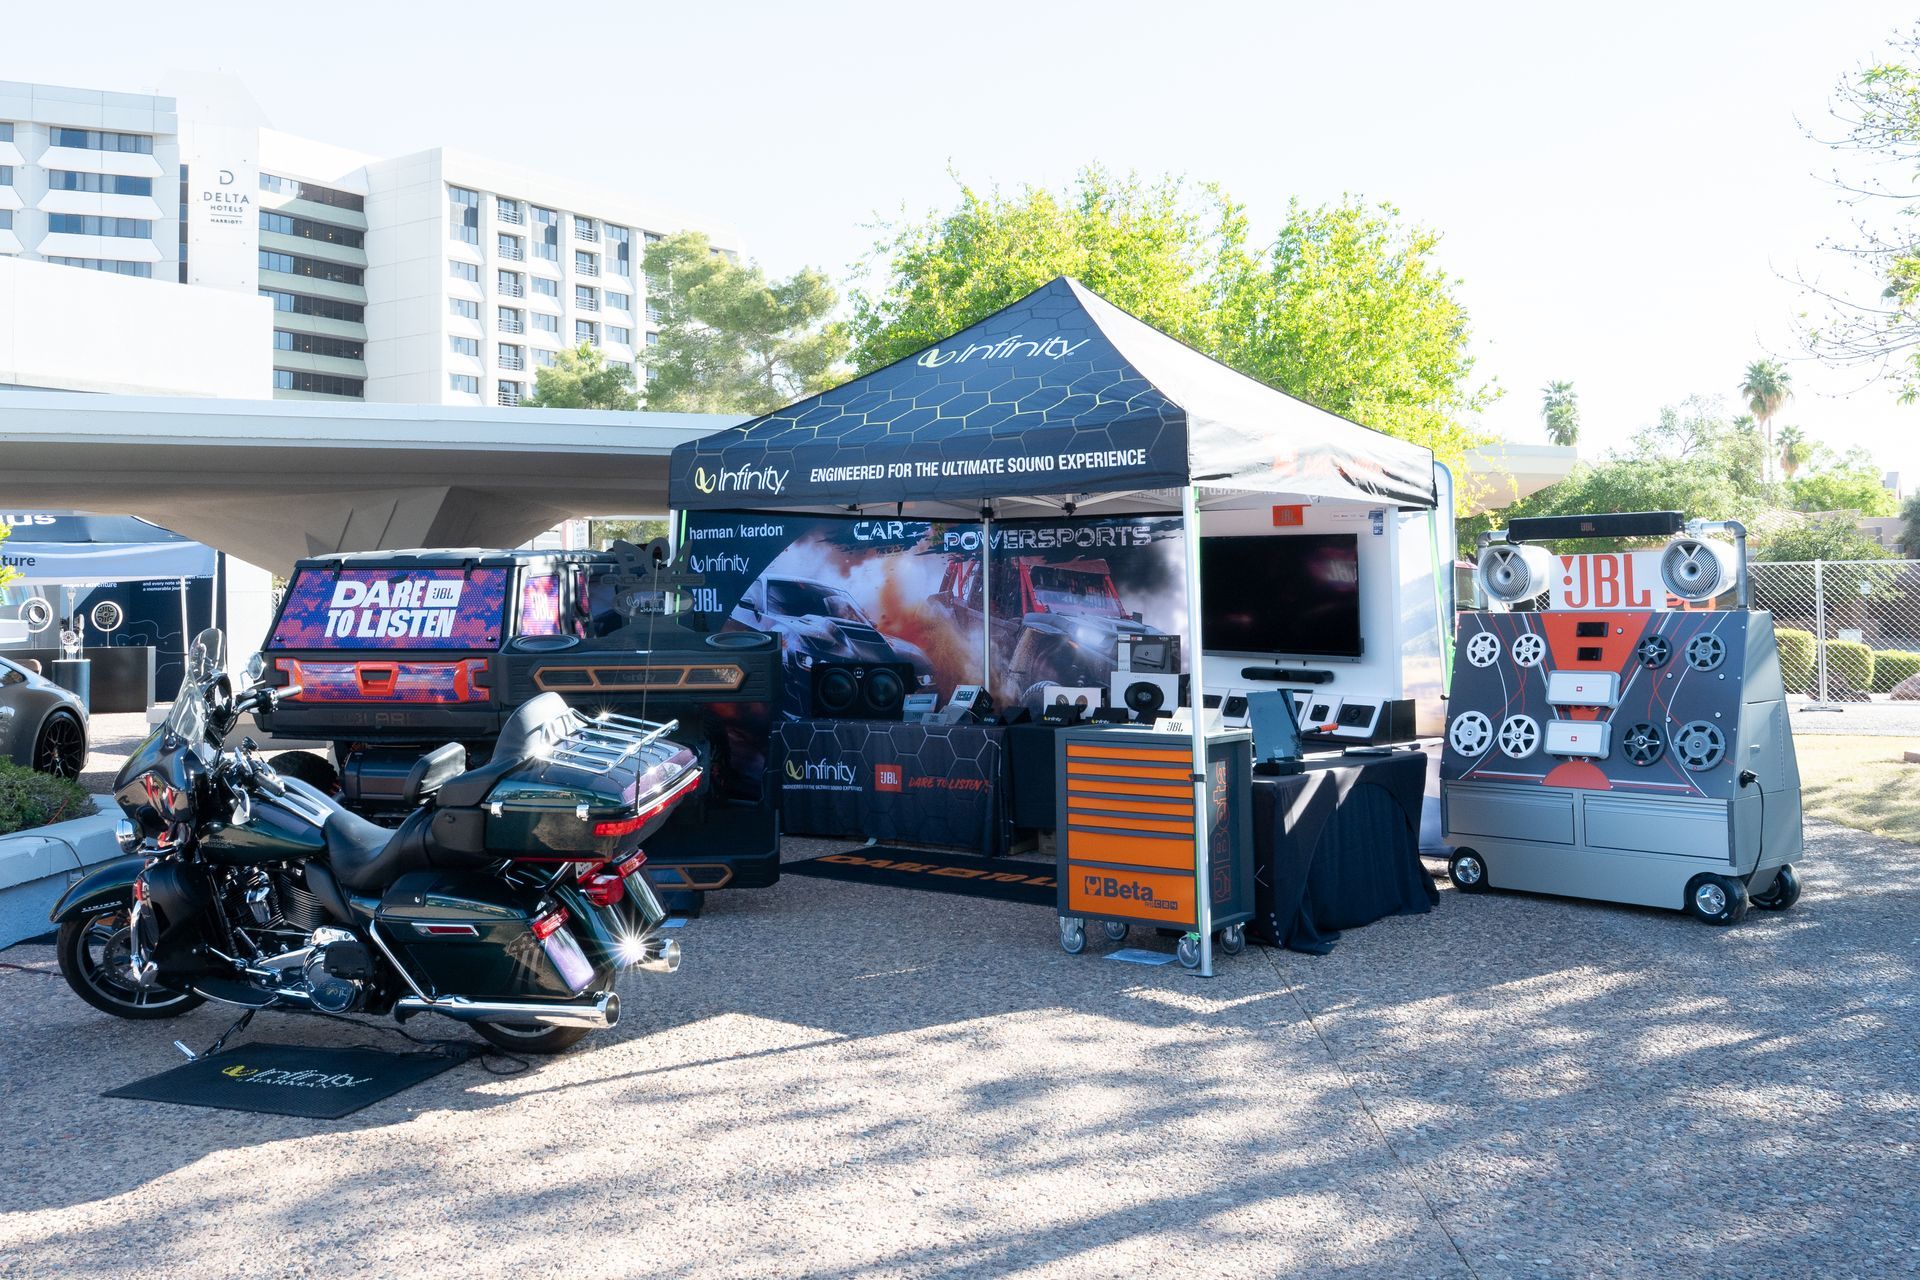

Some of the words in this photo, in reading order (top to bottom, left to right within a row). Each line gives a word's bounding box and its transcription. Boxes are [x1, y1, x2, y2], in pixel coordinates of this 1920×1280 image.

[203, 191, 250, 204] DELTA
[210, 205, 244, 213] HOTELS
[954, 334, 1091, 363] Infinity
[810, 464, 885, 482] ENGINEERED
[888, 462, 912, 479] FOR
[915, 461, 939, 477] THE
[941, 458, 1005, 476] ULTIMATE
[1007, 455, 1055, 473] SOUND
[1058, 449, 1147, 470] EXPERIENCE
[718, 463, 790, 495] Infinity
[853, 521, 905, 541] CAR
[943, 525, 1152, 551] POWERSPORTS
[705, 552, 750, 575] Infinity
[1560, 553, 1651, 609] JBL
[330, 580, 427, 608] DARE
[432, 587, 454, 600] JBL
[692, 588, 723, 612] JBL
[324, 609, 356, 638] TO
[356, 609, 457, 638] LISTEN
[1166, 721, 1183, 732] JBL
[805, 757, 857, 784] Infinity
[880, 771, 898, 785] JBL
[908, 775, 934, 788] DARE
[816, 854, 940, 873] DARE
[979, 871, 1030, 882] TO
[1103, 877, 1154, 901] Beta
